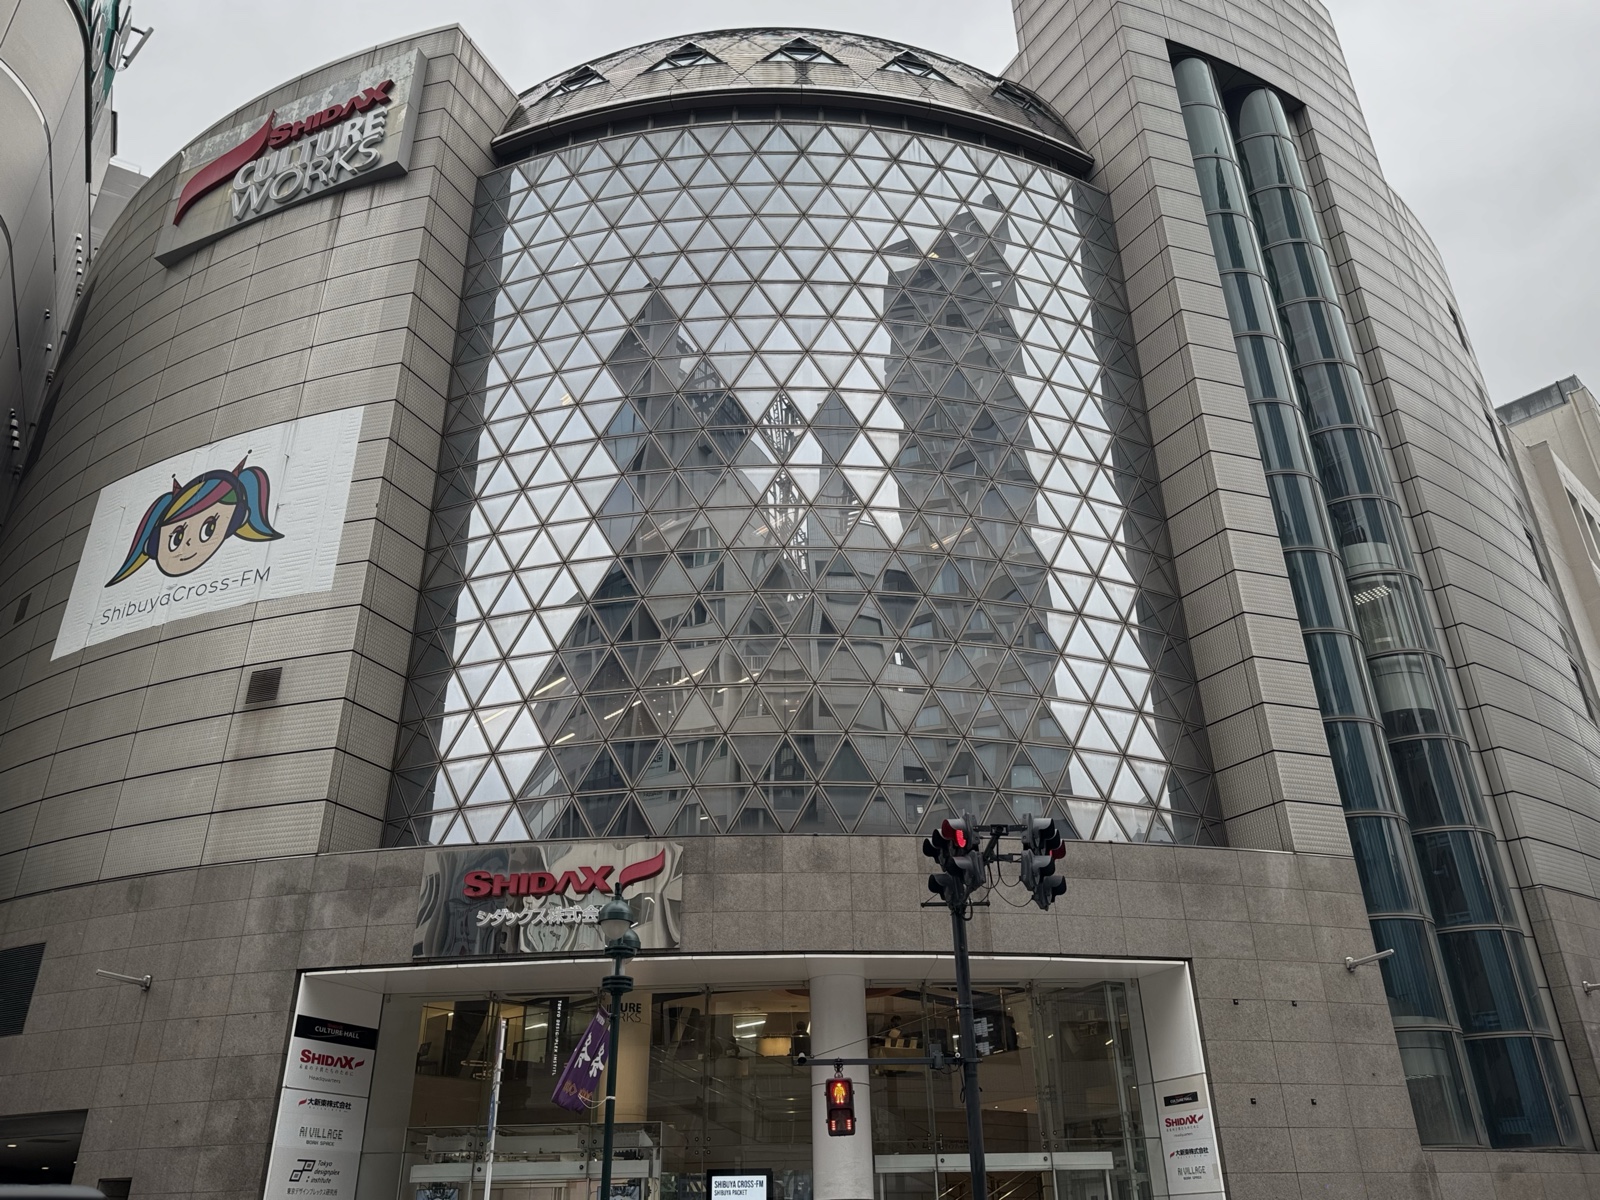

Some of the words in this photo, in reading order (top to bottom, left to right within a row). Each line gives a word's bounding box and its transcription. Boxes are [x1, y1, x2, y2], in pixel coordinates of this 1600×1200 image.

[267, 79, 395, 149] SHIDAX
[233, 107, 388, 194] CULTURE
[231, 135, 382, 221] WORKS
[100, 566, 271, 626] ShibuyaCross-FM
[463, 865, 615, 898] SHIDAX
[476, 904, 605, 927] シダックス株式会
[620, 1012, 642, 1023] RKS
[314, 1025, 343, 1036] CULTURE
[343, 1031, 360, 1039] HALL
[300, 1049, 355, 1070] SHIDAX
[308, 1098, 351, 1109] 大新東株式会社
[1165, 1114, 1197, 1127] SHIDAX
[309, 1127, 343, 1139] VILLAGE
[314, 1168, 340, 1176] designplex
